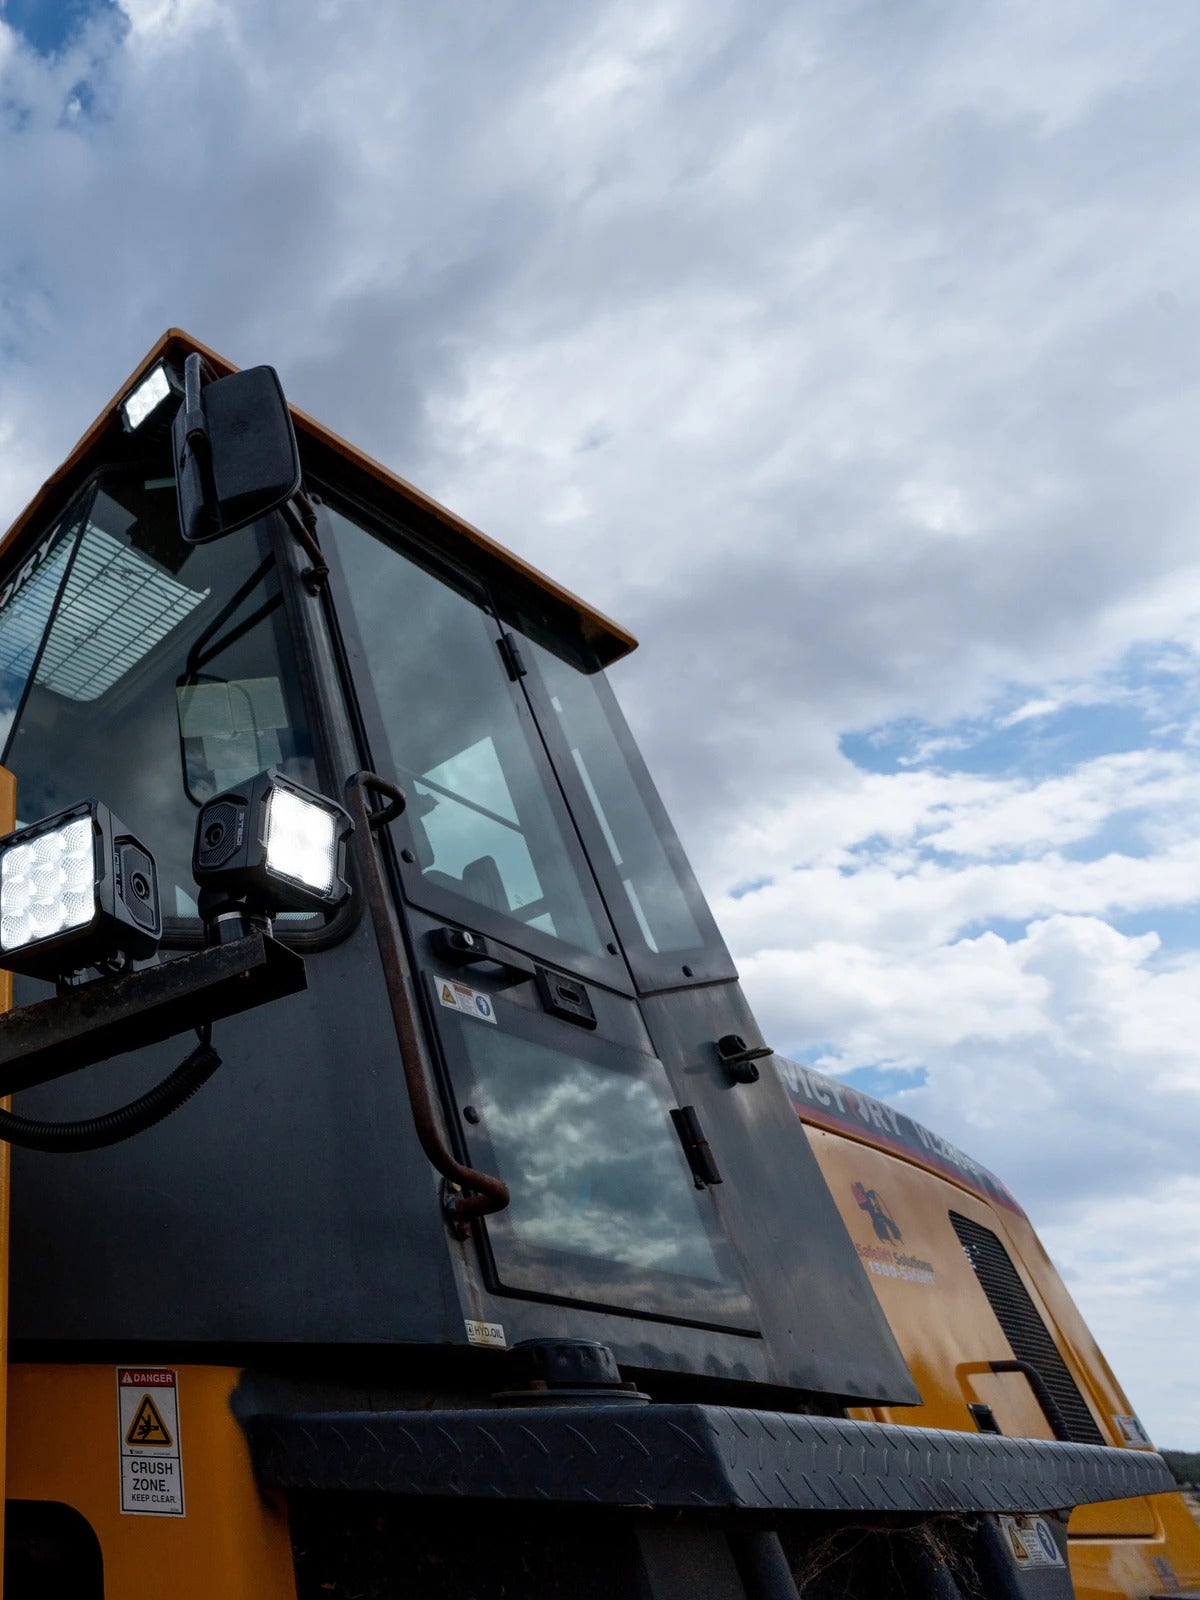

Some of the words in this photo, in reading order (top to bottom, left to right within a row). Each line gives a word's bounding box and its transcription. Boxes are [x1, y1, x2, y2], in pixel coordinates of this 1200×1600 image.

[133, 1373, 173, 1383] DANGER
[131, 1461, 173, 1475] CRUSH
[132, 1478, 170, 1492] ZONE.
[131, 1493, 150, 1502] KEEP
